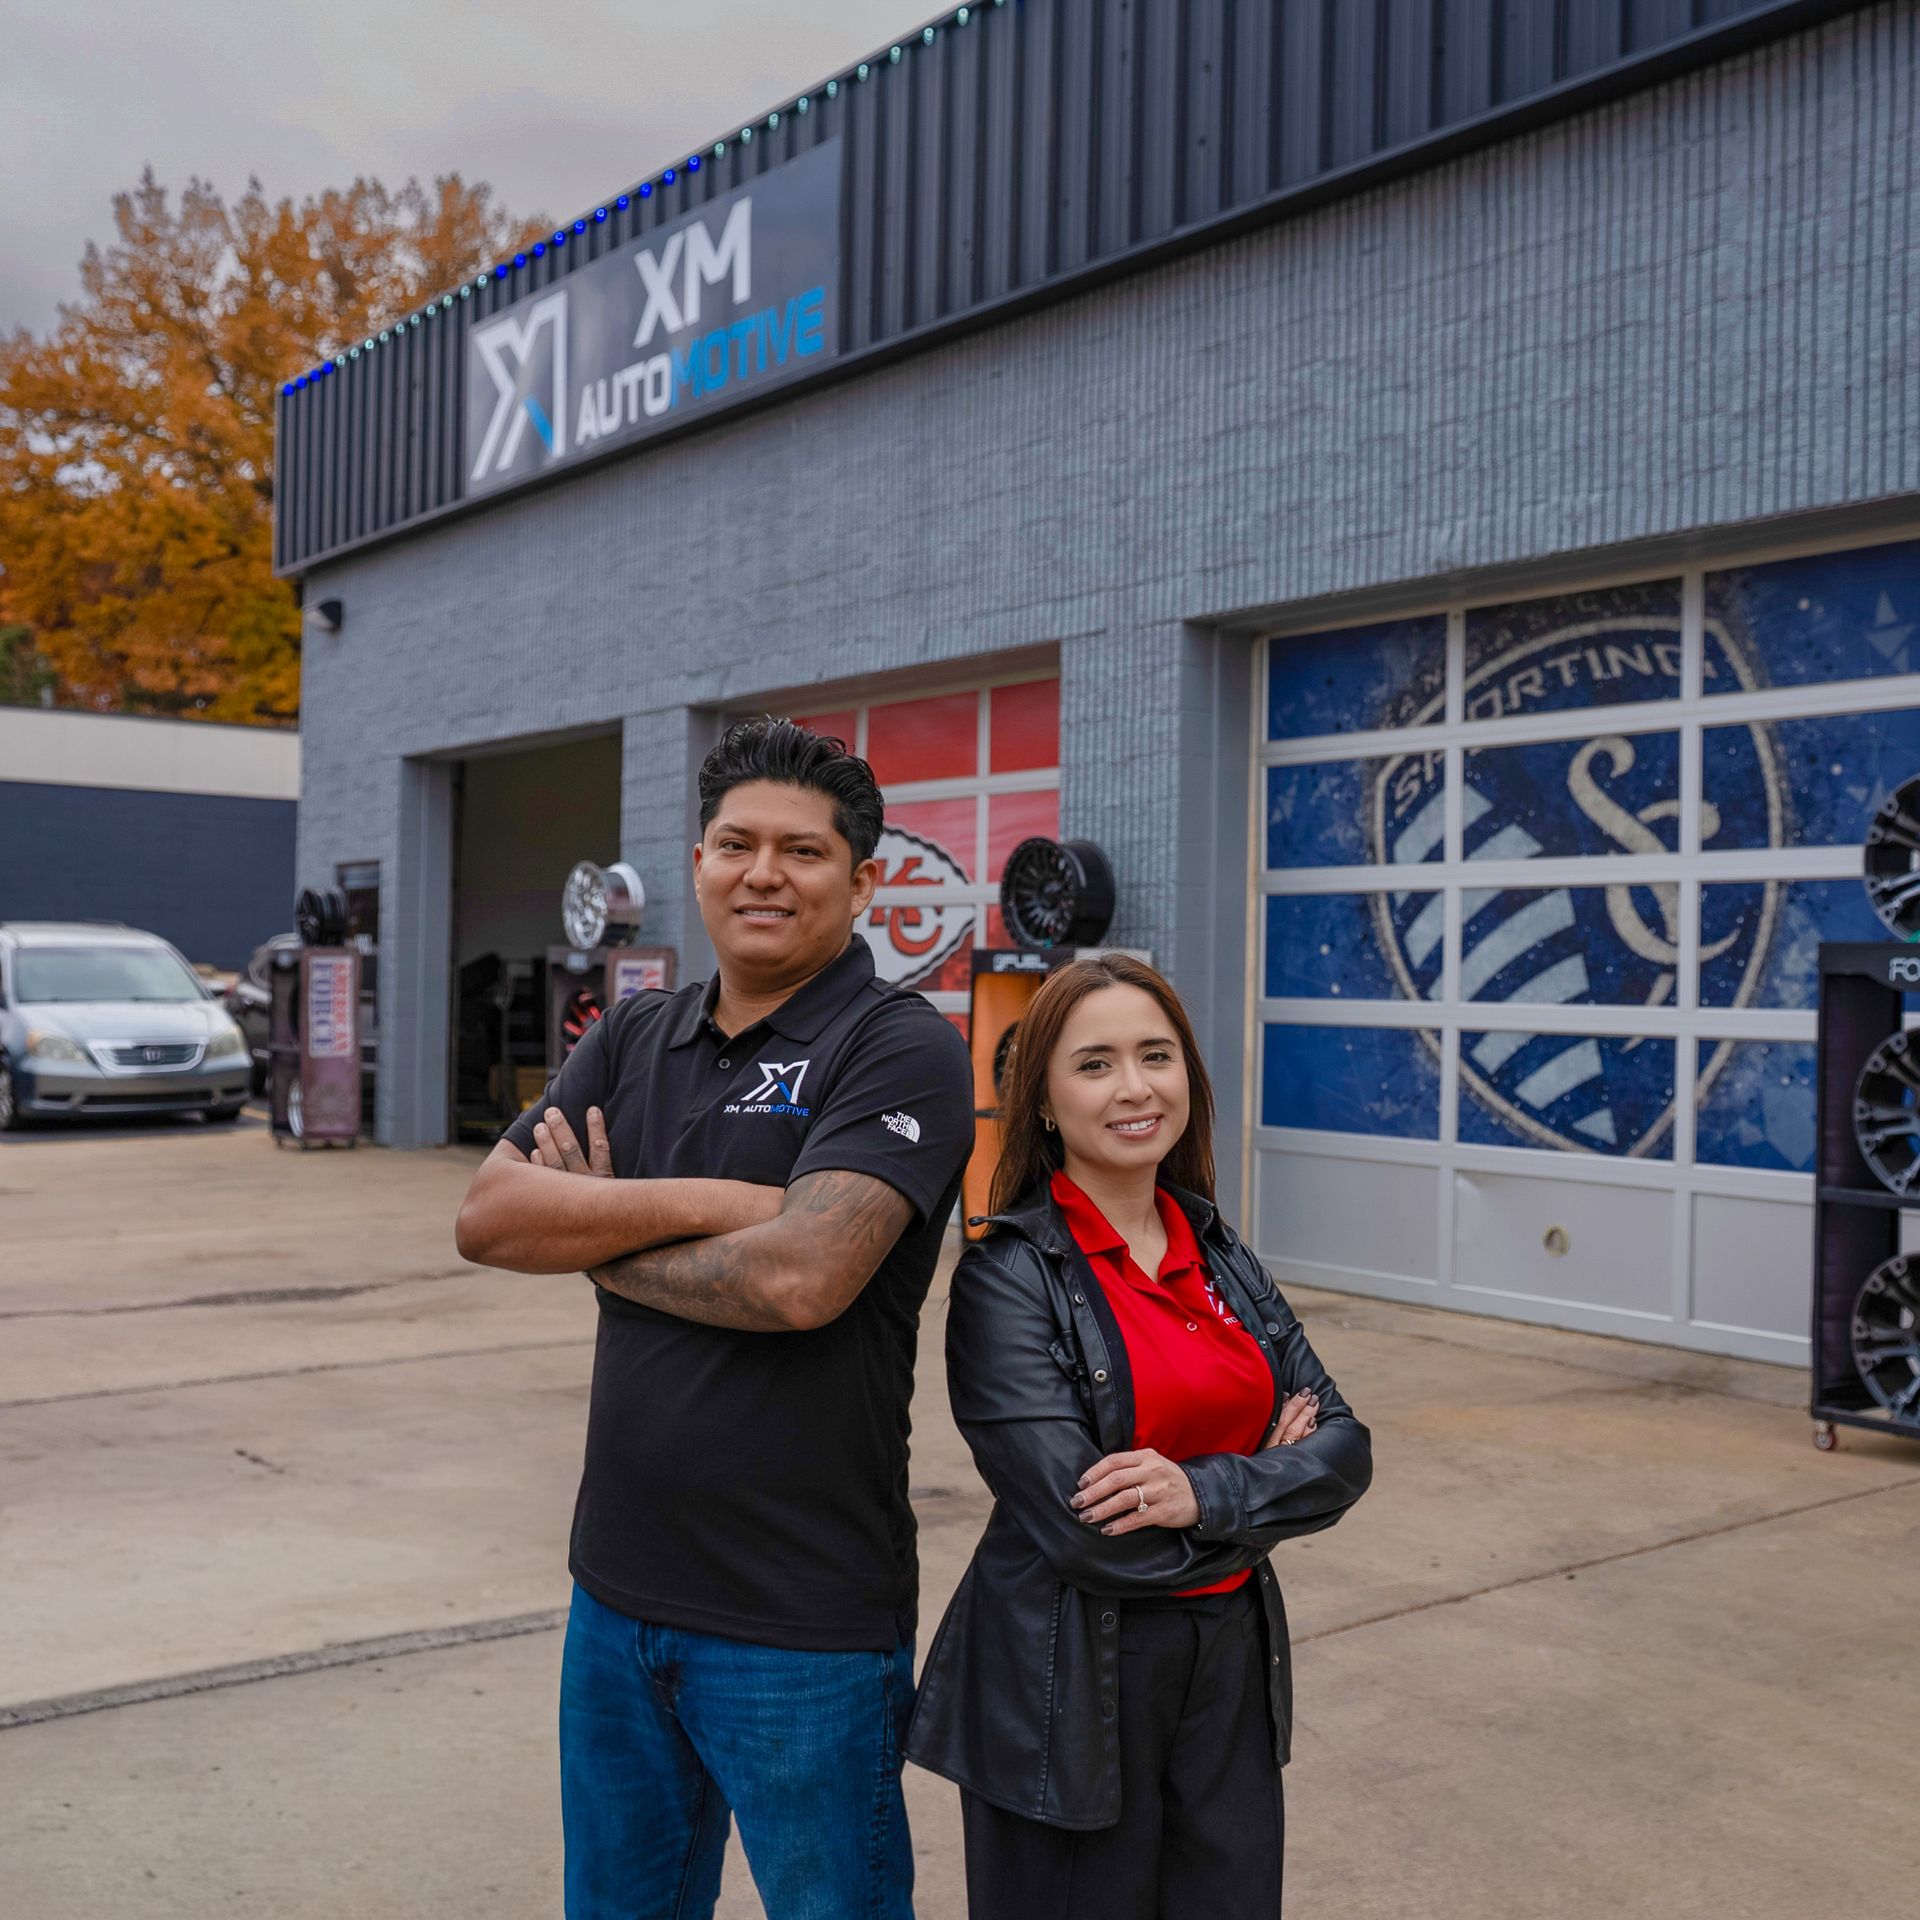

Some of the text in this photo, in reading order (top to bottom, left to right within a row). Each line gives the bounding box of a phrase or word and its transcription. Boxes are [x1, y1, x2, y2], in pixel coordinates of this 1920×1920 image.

[633, 197, 752, 348] XM
[576, 286, 824, 446] AUTOMOTIVE
[723, 1104, 810, 1117] XM AUTOMOTIVE
[896, 1111, 912, 1123] THE
[881, 1114, 910, 1130] NORTH
[887, 1121, 907, 1136] FACE
